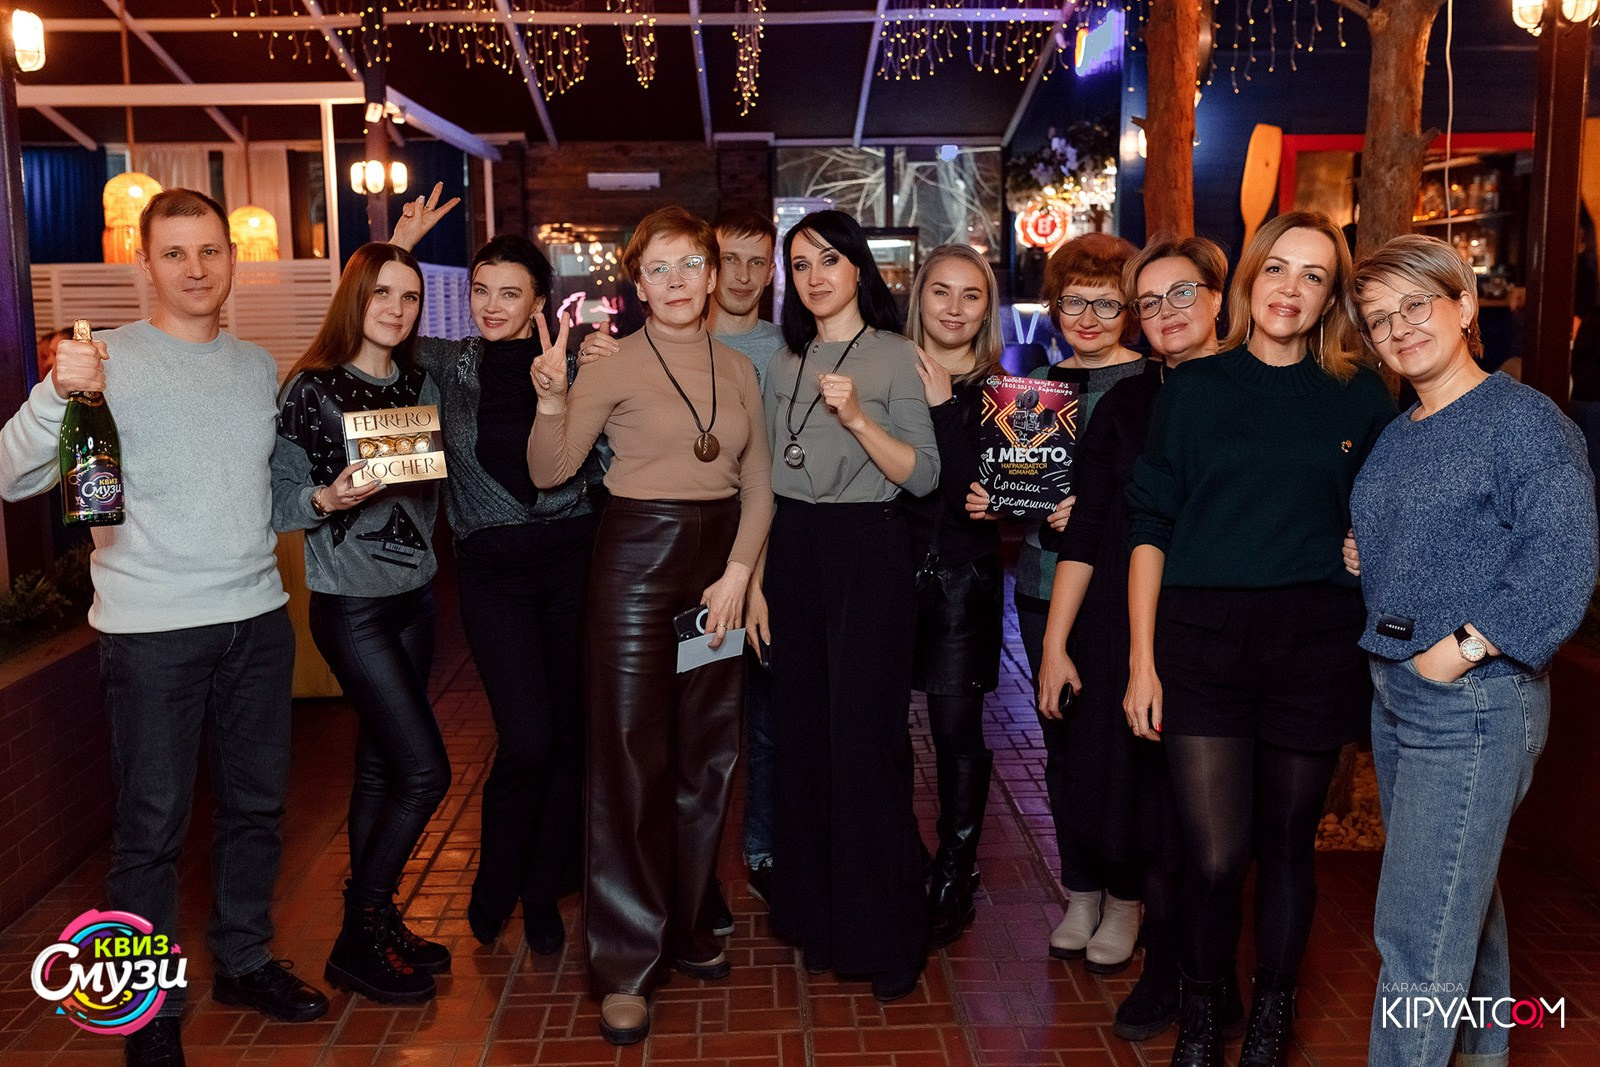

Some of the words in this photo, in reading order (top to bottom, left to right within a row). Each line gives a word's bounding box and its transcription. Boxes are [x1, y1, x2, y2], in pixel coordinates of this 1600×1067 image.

[352, 410, 432, 432] FERRERO
[986, 447, 996, 463] 1
[998, 447, 1067, 463] МЕСТО
[360, 457, 440, 480] ROCHER
[81, 481, 121, 498] Смузи
[99, 478, 118, 486] КВИЗ
